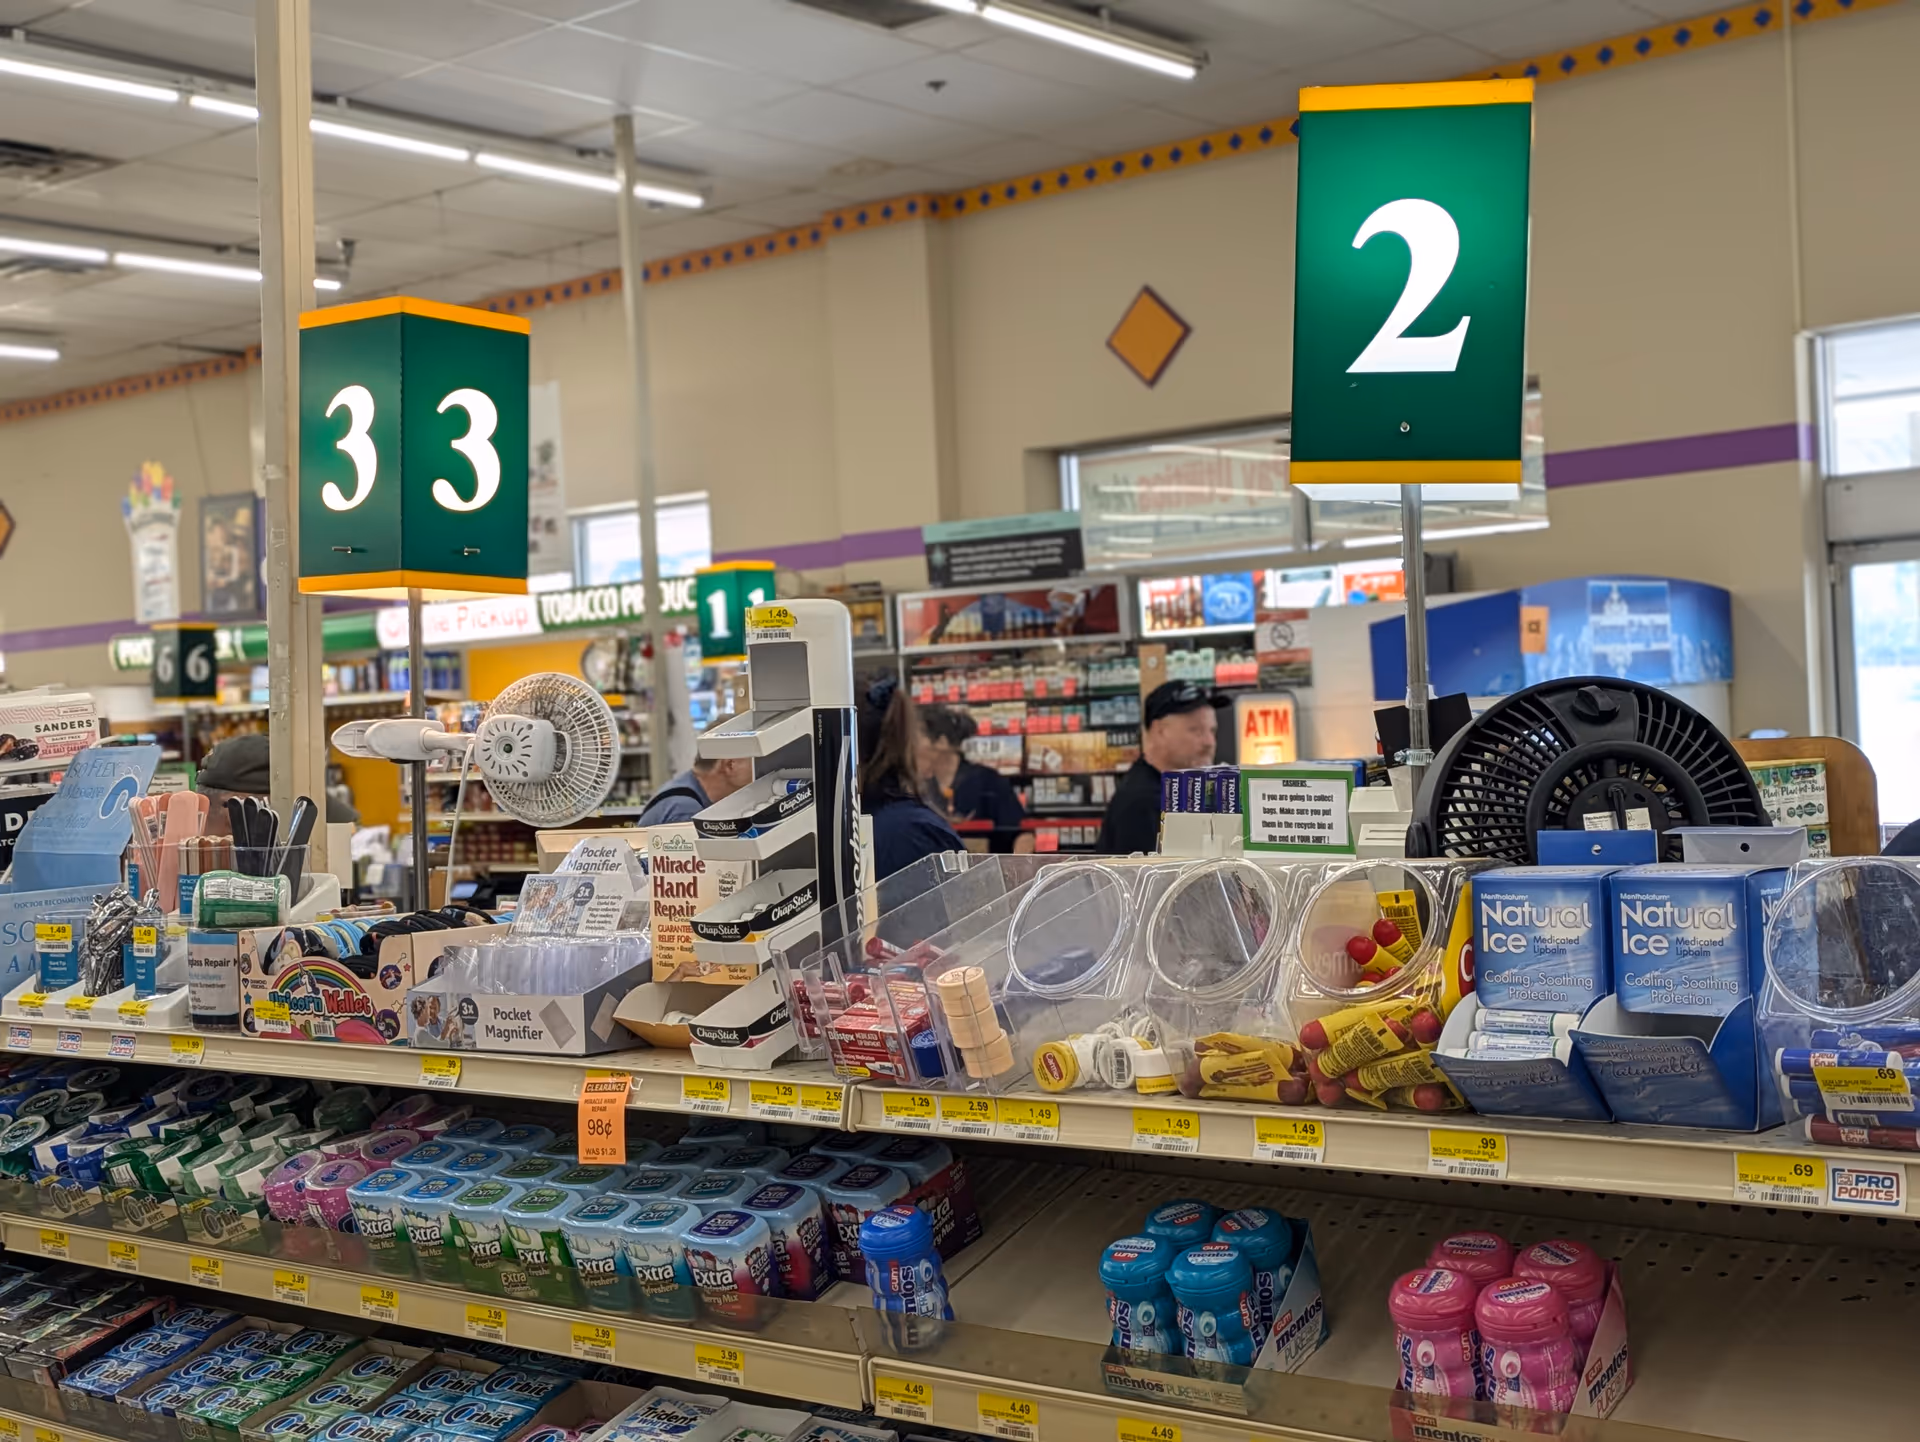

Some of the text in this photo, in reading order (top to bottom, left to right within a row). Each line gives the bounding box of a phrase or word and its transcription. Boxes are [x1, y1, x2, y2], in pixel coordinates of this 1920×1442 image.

[1346, 199, 1470, 373] 2
[322, 385, 378, 511] 3
[433, 388, 501, 512] 3
[541, 587, 618, 624] TOBACCO
[706, 590, 732, 638] 1
[768, 609, 788, 618] 1.49
[157, 645, 174, 683] 6
[187, 644, 211, 682] 6
[34, 719, 93, 733] SANDERS
[1245, 709, 1291, 738] ATM
[779, 787, 813, 813] ChapStick
[1171, 777, 1179, 812] TROJAN
[1194, 777, 1202, 812] TROJAN
[1267, 794, 1277, 802] you
[1289, 793, 1305, 802] going
[1314, 794, 1334, 802] collect
[1279, 807, 1295, 815] Make
[1322, 808, 1332, 816] put
[702, 821, 737, 831] ChapStick
[1262, 820, 1276, 828] them
[1277, 820, 1283, 828] in
[1284, 820, 1293, 828] the
[1295, 822, 1316, 830] recycle
[1327, 822, 1334, 830] at
[1268, 834, 1277, 842] the
[1278, 834, 1289, 842] end
[1297, 835, 1310, 843] YOUR
[1311, 835, 1326, 844] SHIFT
[580, 847, 617, 858] Pocket
[568, 860, 622, 874] Magnifier
[652, 855, 706, 874] Miracle
[577, 885, 591, 897] 3x
[653, 876, 699, 899] Hand
[654, 900, 697, 922] Repair
[771, 889, 813, 921] ChapStick
[1480, 901, 1592, 928] Natural
[1620, 901, 1738, 930] Natural
[50, 926, 66, 934] 1.49
[138, 929, 151, 937] 1.49
[658, 925, 693, 933] GUARANTEE
[697, 924, 741, 936] ChapStick
[658, 935, 692, 943] RELIEF FOR:
[1482, 927, 1528, 954] Ice
[1533, 935, 1580, 945] Medicated
[1622, 928, 1669, 956] Ice
[1675, 937, 1725, 947] Medicated
[1533, 945, 1567, 956] Lipbalm
[1675, 947, 1711, 958] Lipbalm
[204, 957, 230, 968] Repair
[1484, 970, 1594, 990] Cooling, Soothing
[1625, 972, 1739, 995] Cooling, Soothing
[322, 989, 372, 1014] Wallet
[1508, 987, 1568, 1002] Protection
[1651, 990, 1713, 1005] Protection
[461, 1003, 474, 1014] 3x
[493, 1006, 532, 1022] Pocket
[485, 1023, 543, 1042] Magnifier
[697, 1027, 740, 1041] ChapStick
[828, 1031, 855, 1043] Blistex
[120, 1038, 134, 1046] PRO
[187, 1041, 200, 1049] 1.99
[446, 1059, 456, 1069] .99
[1875, 1068, 1896, 1079] .69
[586, 1083, 625, 1092] CLEARANCE
[708, 1080, 724, 1091] 1.49
[775, 1085, 793, 1096] 1.29
[826, 1091, 843, 1102] 2.59
[911, 1097, 930, 1107] 1.29
[969, 1101, 988, 1112] 2.59
[1029, 1108, 1052, 1119] 1.49
[588, 1119, 612, 1139] 98¢
[1165, 1118, 1190, 1130] 1.49
[1292, 1123, 1316, 1135] 1.49
[1478, 1137, 1497, 1149] .99
[1789, 1164, 1813, 1176] .69
[1855, 1175, 1894, 1189] PRO
[50, 1182, 84, 1213] Orbit
[1837, 1186, 1894, 1201] POINTS
[72, 1198, 92, 1210] WHITE
[122, 1195, 159, 1226] Orbit
[146, 1211, 166, 1224] WHITE
[226, 1223, 247, 1236] WHITE
[360, 1219, 392, 1236] Extra
[408, 1226, 441, 1243] Extra
[576, 1257, 615, 1275] Extra
[636, 1264, 675, 1283] Extra
[292, 1275, 305, 1284] 3.99
[501, 1270, 527, 1285] Extra
[695, 1267, 734, 1286] Extra
[891, 1267, 899, 1292] GUM
[380, 1290, 394, 1300] 3.99
[1494, 1285, 1547, 1300] mentos
[487, 1310, 502, 1319] 3.99
[1276, 1298, 1322, 1352] mentos
[594, 1328, 610, 1339] 3.99
[121, 1333, 181, 1355] Orbit
[720, 1350, 737, 1361] 3.99
[76, 1359, 134, 1383] Orbit
[241, 1360, 301, 1382] Orbit
[1589, 1345, 1628, 1404] mentos
[483, 1372, 551, 1398] Orbit
[904, 1383, 924, 1395] 4.49
[1108, 1374, 1165, 1393] mentos
[308, 1384, 369, 1408] Orbit
[374, 1399, 436, 1424] Orbit
[442, 1402, 513, 1428] Orbit
[1010, 1401, 1030, 1415] 4.49
[637, 1416, 675, 1432] WHITE
[639, 1406, 700, 1427] Trident
[326, 1415, 394, 1442] Orbit
[1151, 1426, 1174, 1439] 4.49
[1414, 1426, 1482, 1442] mentos
